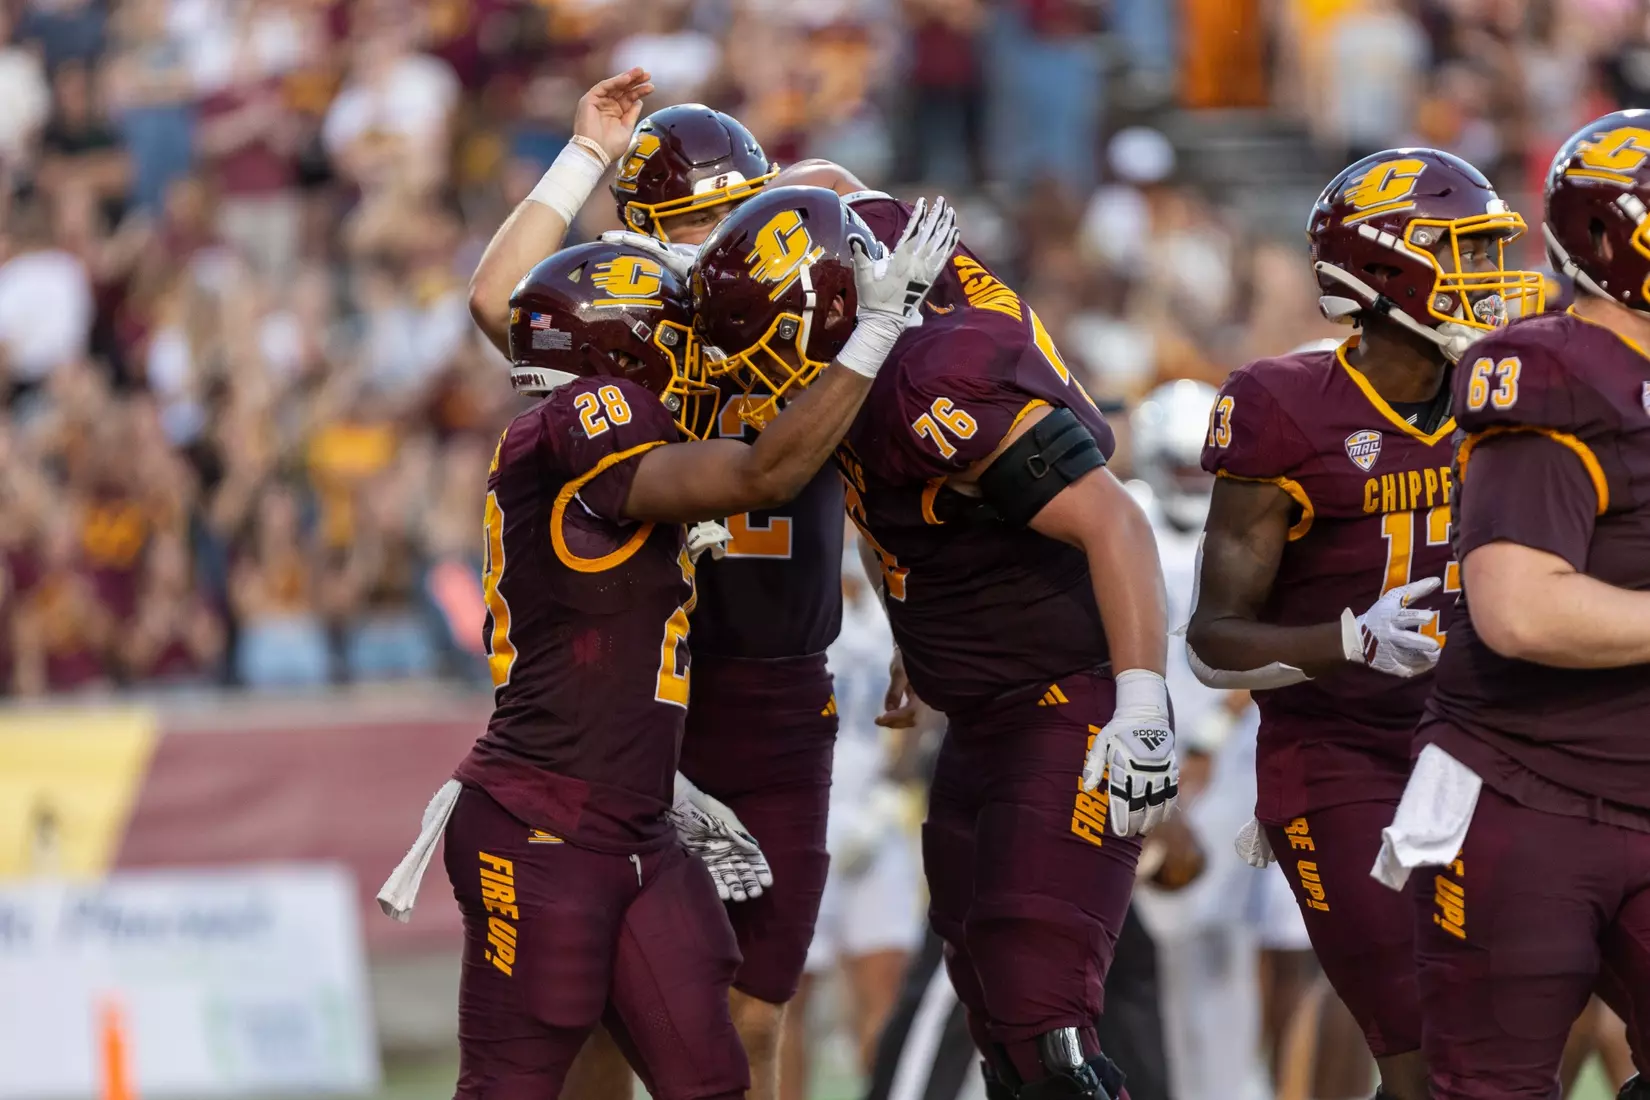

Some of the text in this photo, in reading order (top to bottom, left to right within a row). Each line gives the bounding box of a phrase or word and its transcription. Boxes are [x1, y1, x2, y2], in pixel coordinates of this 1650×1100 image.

[1467, 356, 1522, 411] 63
[573, 385, 632, 440] 28
[912, 397, 978, 460] 76
[1209, 395, 1235, 448] 13
[1349, 441, 1381, 457] MAC
[1132, 729, 1169, 738] adidas
[479, 850, 520, 977] FIRE UP!
[1297, 859, 1330, 913] UP!
[1432, 874, 1467, 940] UP!
